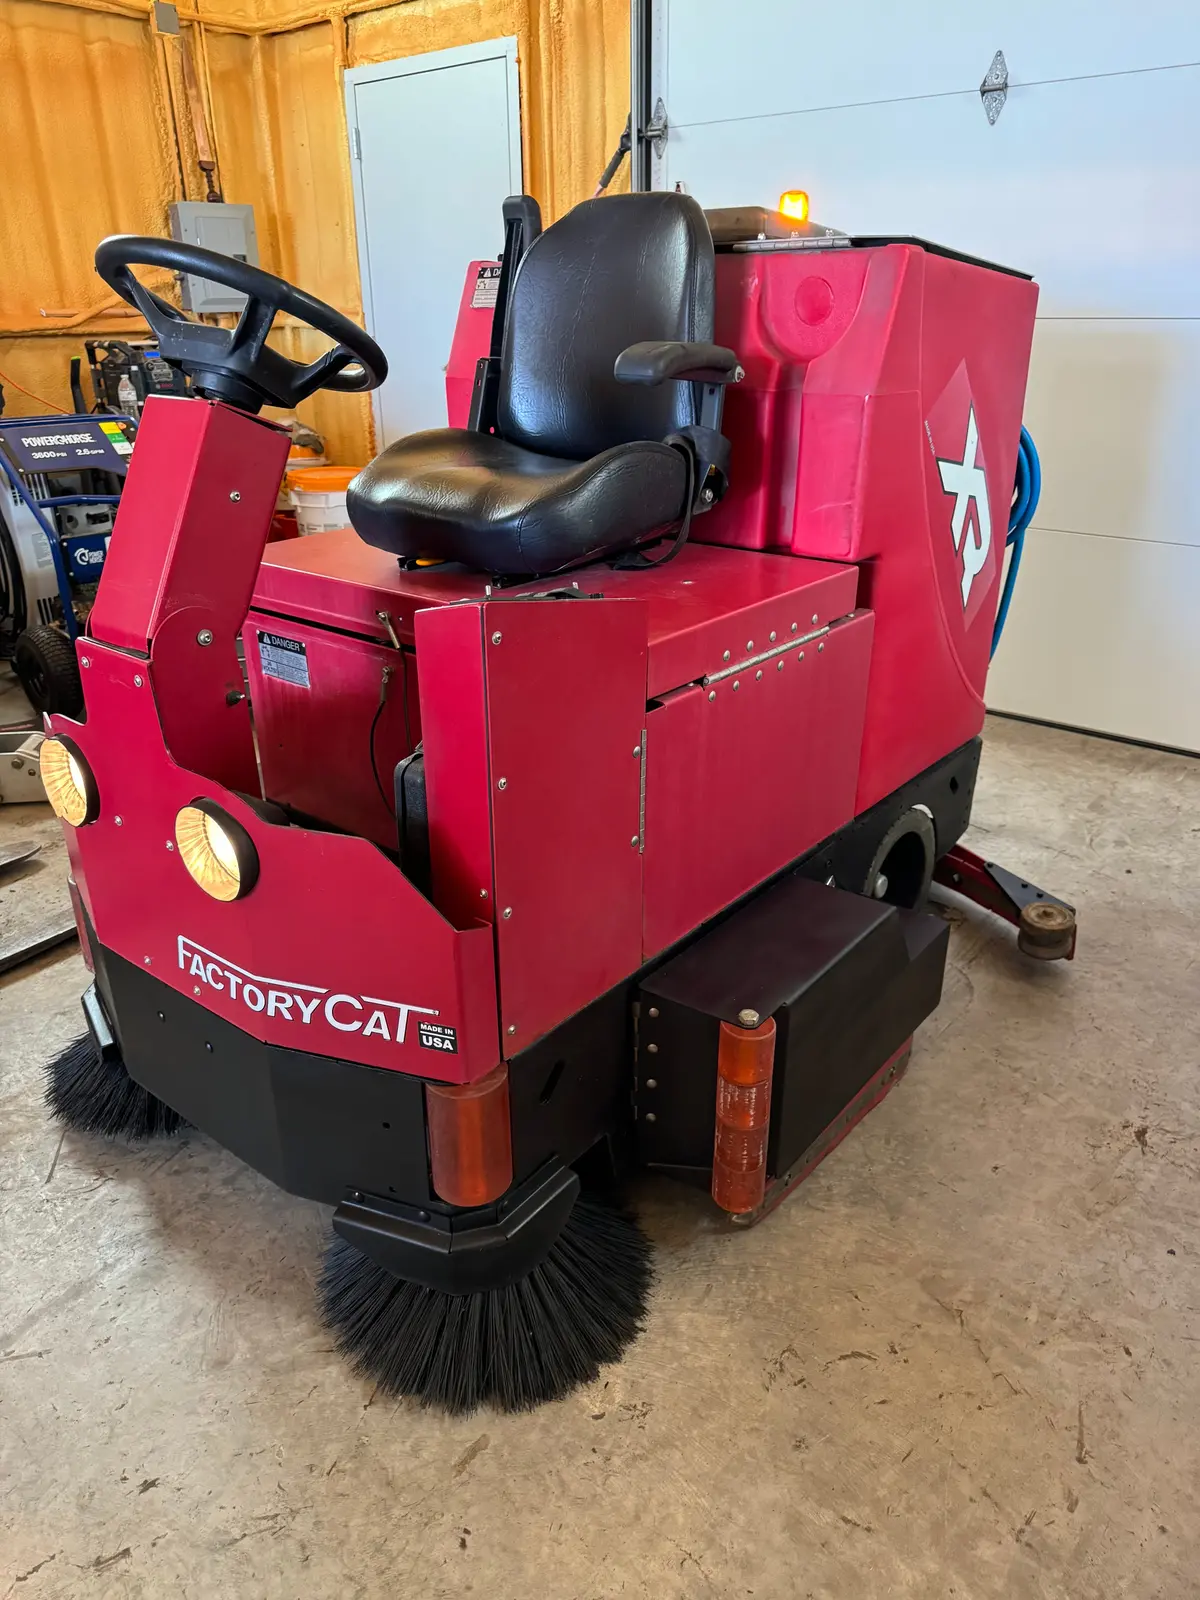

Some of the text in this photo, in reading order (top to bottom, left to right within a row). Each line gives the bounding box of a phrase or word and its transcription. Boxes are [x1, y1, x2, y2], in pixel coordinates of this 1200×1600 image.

[271, 636, 300, 652] DANGER
[420, 1023, 443, 1033] MADE
[422, 1035, 454, 1050] USA
